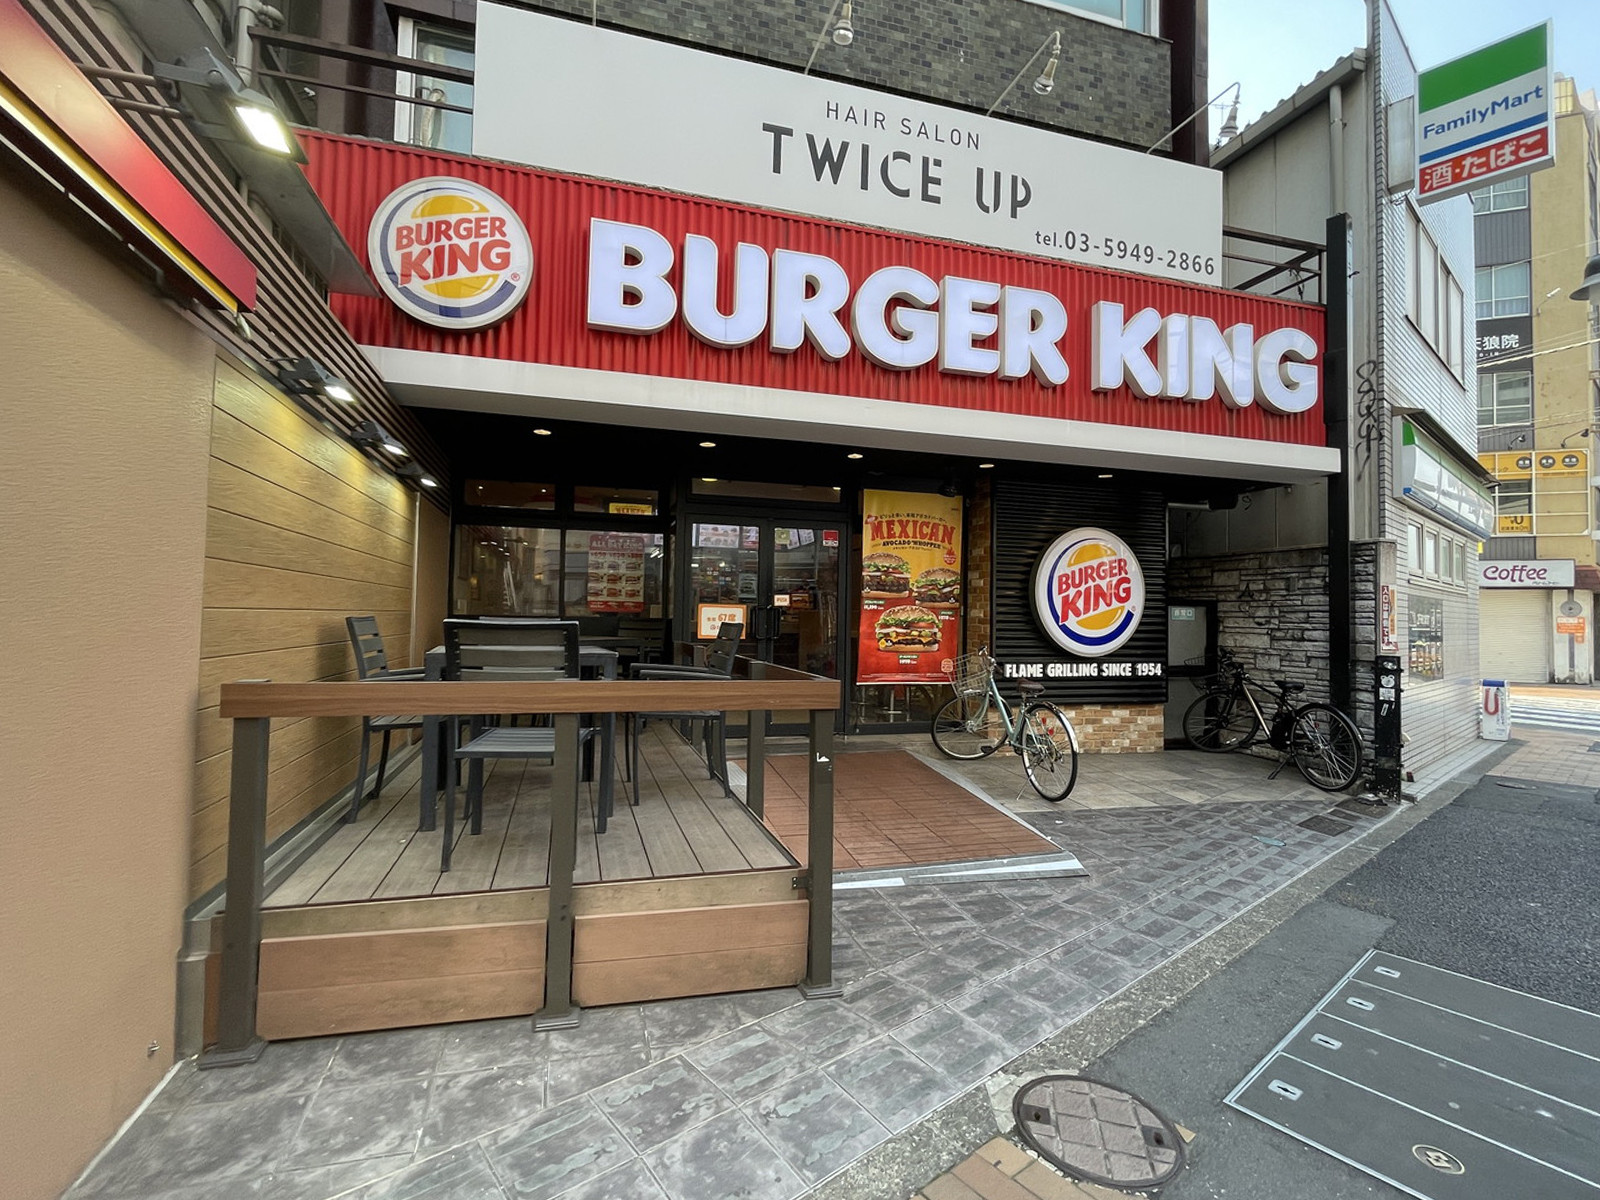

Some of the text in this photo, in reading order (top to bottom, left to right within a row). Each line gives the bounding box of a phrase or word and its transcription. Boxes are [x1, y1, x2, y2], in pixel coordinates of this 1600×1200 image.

[826, 100, 981, 151] HAIR SALON
[1423, 85, 1544, 140] FamilyMart
[762, 122, 1032, 220] TWICE UP
[1424, 134, 1544, 191] 酒・たばこ
[395, 217, 508, 252] BURGER
[398, 239, 512, 289] KING
[587, 217, 1319, 415] BURGER KING
[869, 518, 957, 545] MEXICAN
[882, 539, 911, 547] AVOCADO
[1057, 558, 1129, 596] BURGER
[1482, 565, 1548, 583] Coffee
[1060, 577, 1132, 624] KING
[1005, 662, 1162, 678] FLAME GRILLING SINCE 1954
